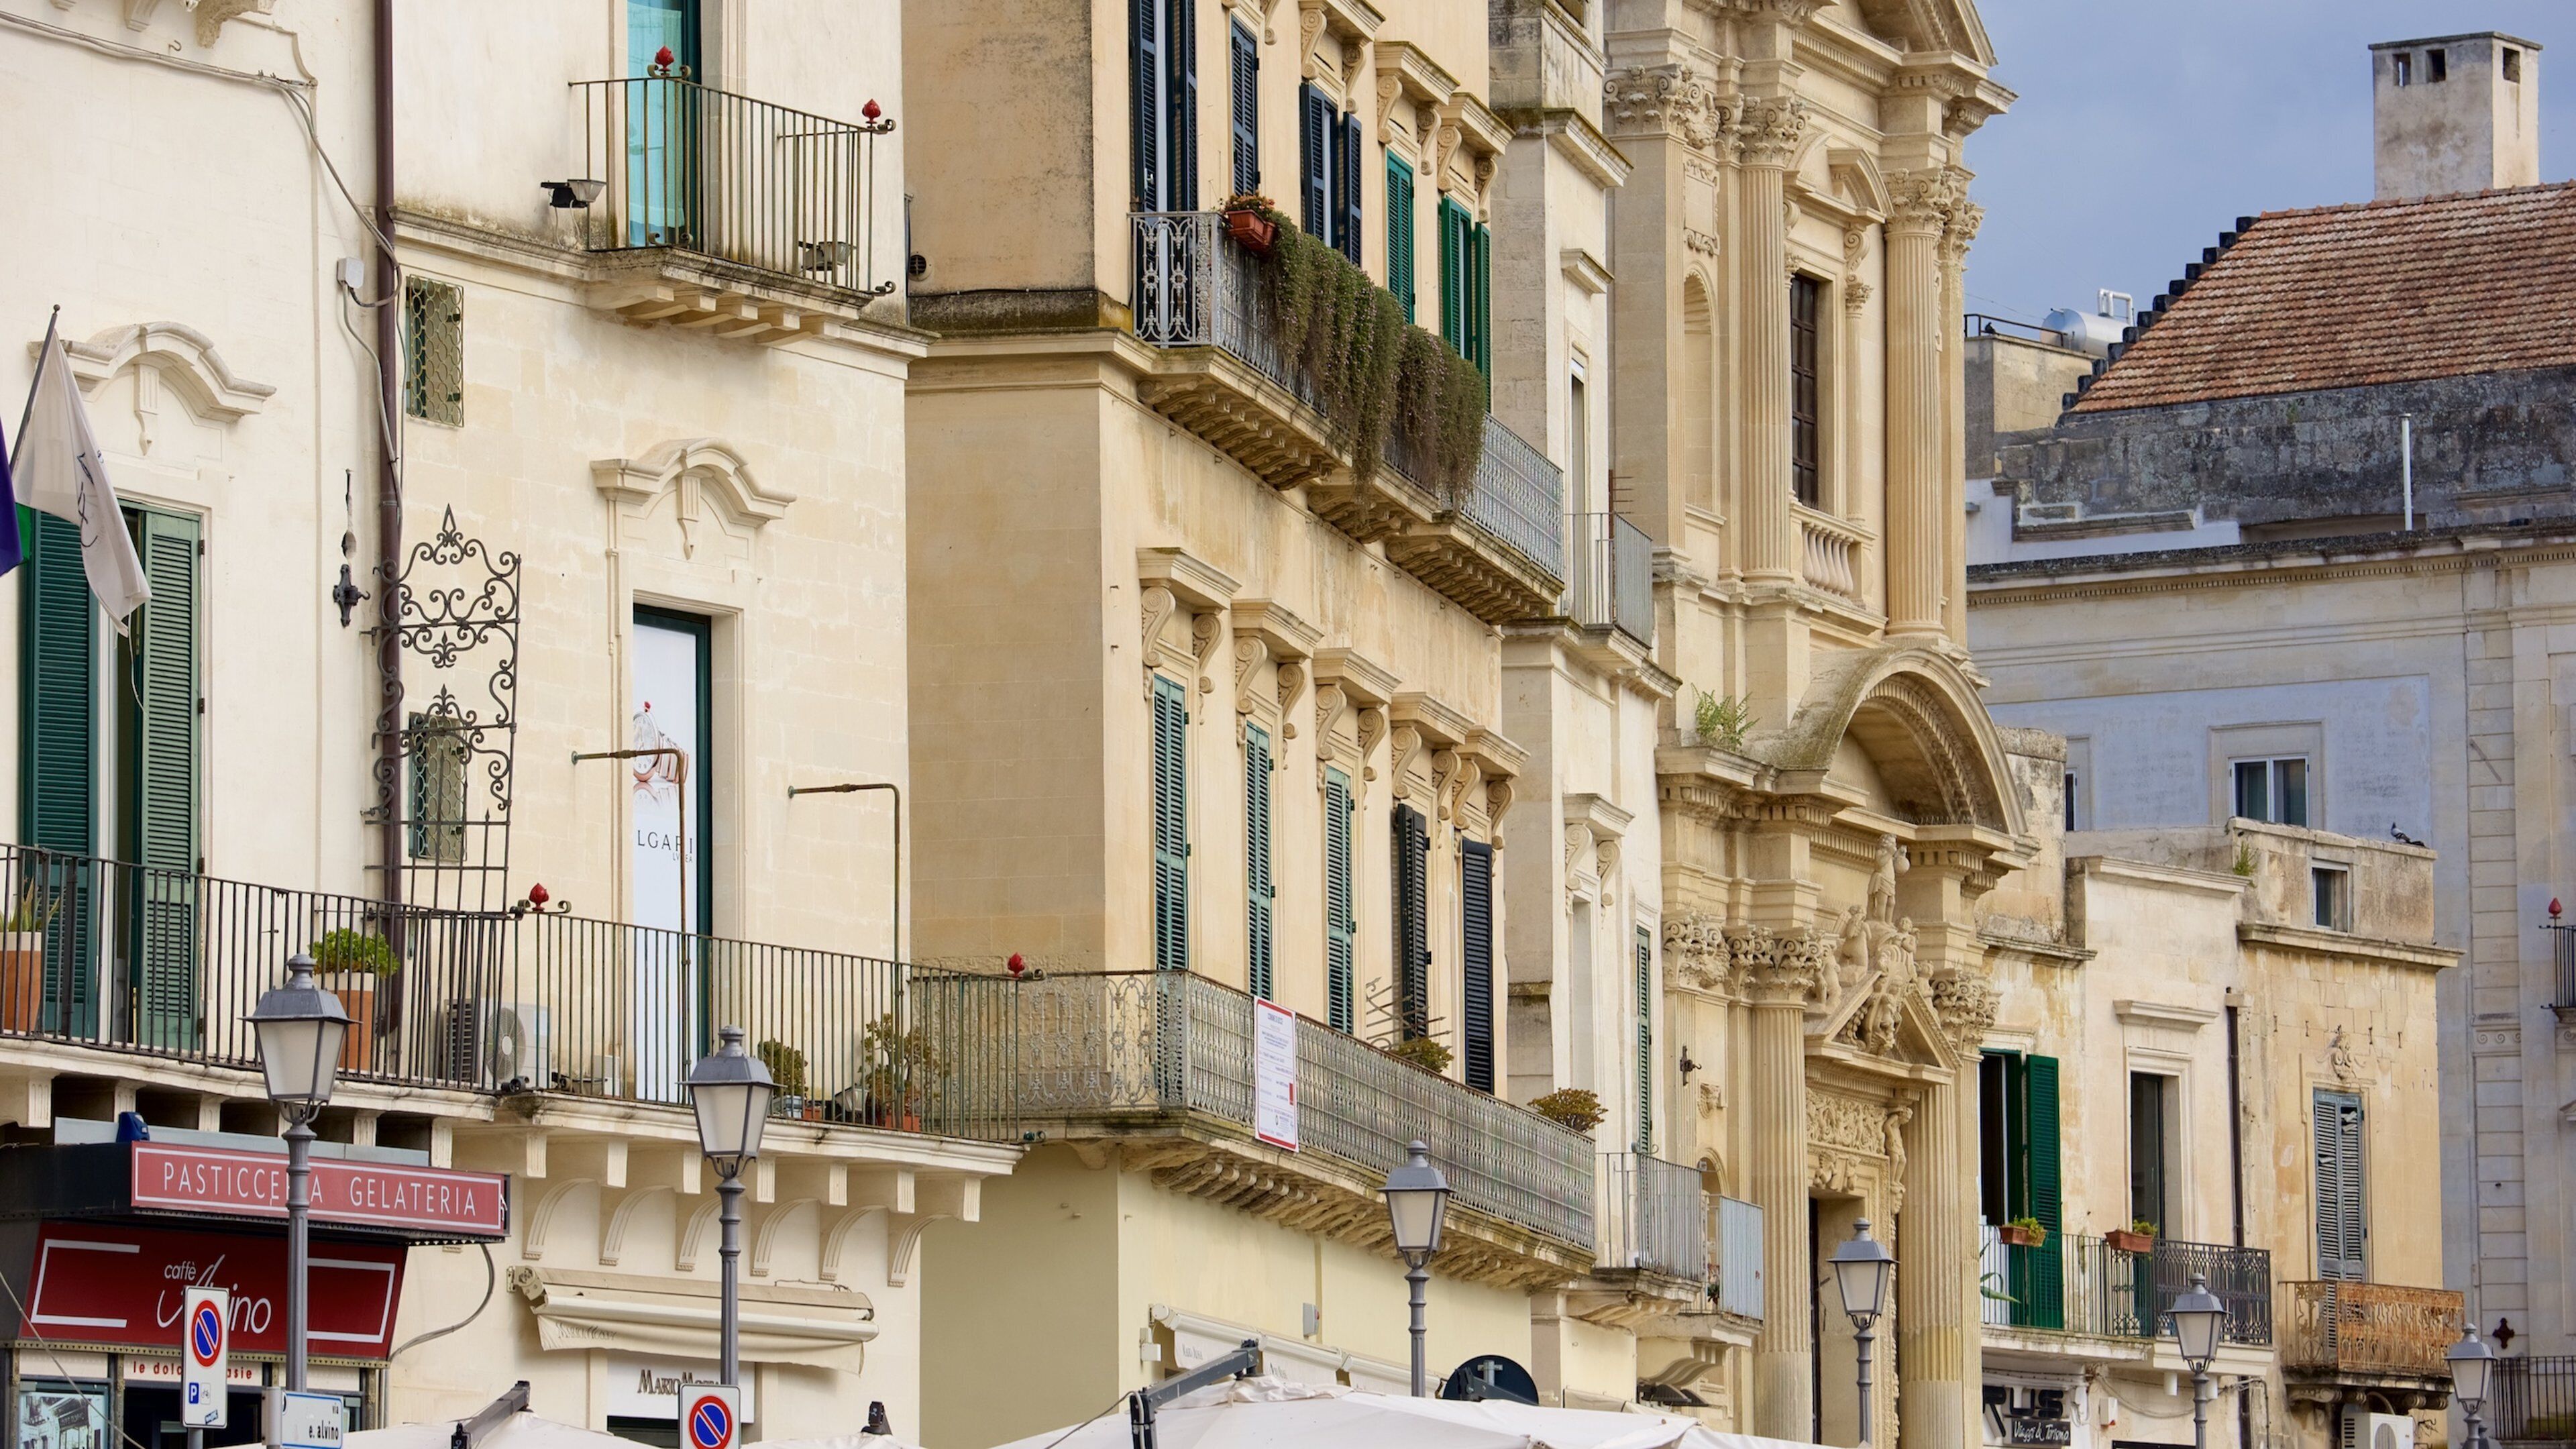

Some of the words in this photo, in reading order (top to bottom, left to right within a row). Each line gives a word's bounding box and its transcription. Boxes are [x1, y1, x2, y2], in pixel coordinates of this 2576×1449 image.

[673, 852, 692, 863] LVEA
[164, 1161, 323, 1203] PASTICCEA
[350, 1176, 476, 1217] GELATERIA
[164, 1260, 197, 1281] caffè
[156, 1254, 272, 1334] Aino
[133, 1360, 146, 1374] le
[153, 1362, 182, 1376] dolc
[317, 1419, 339, 1440] alvino
